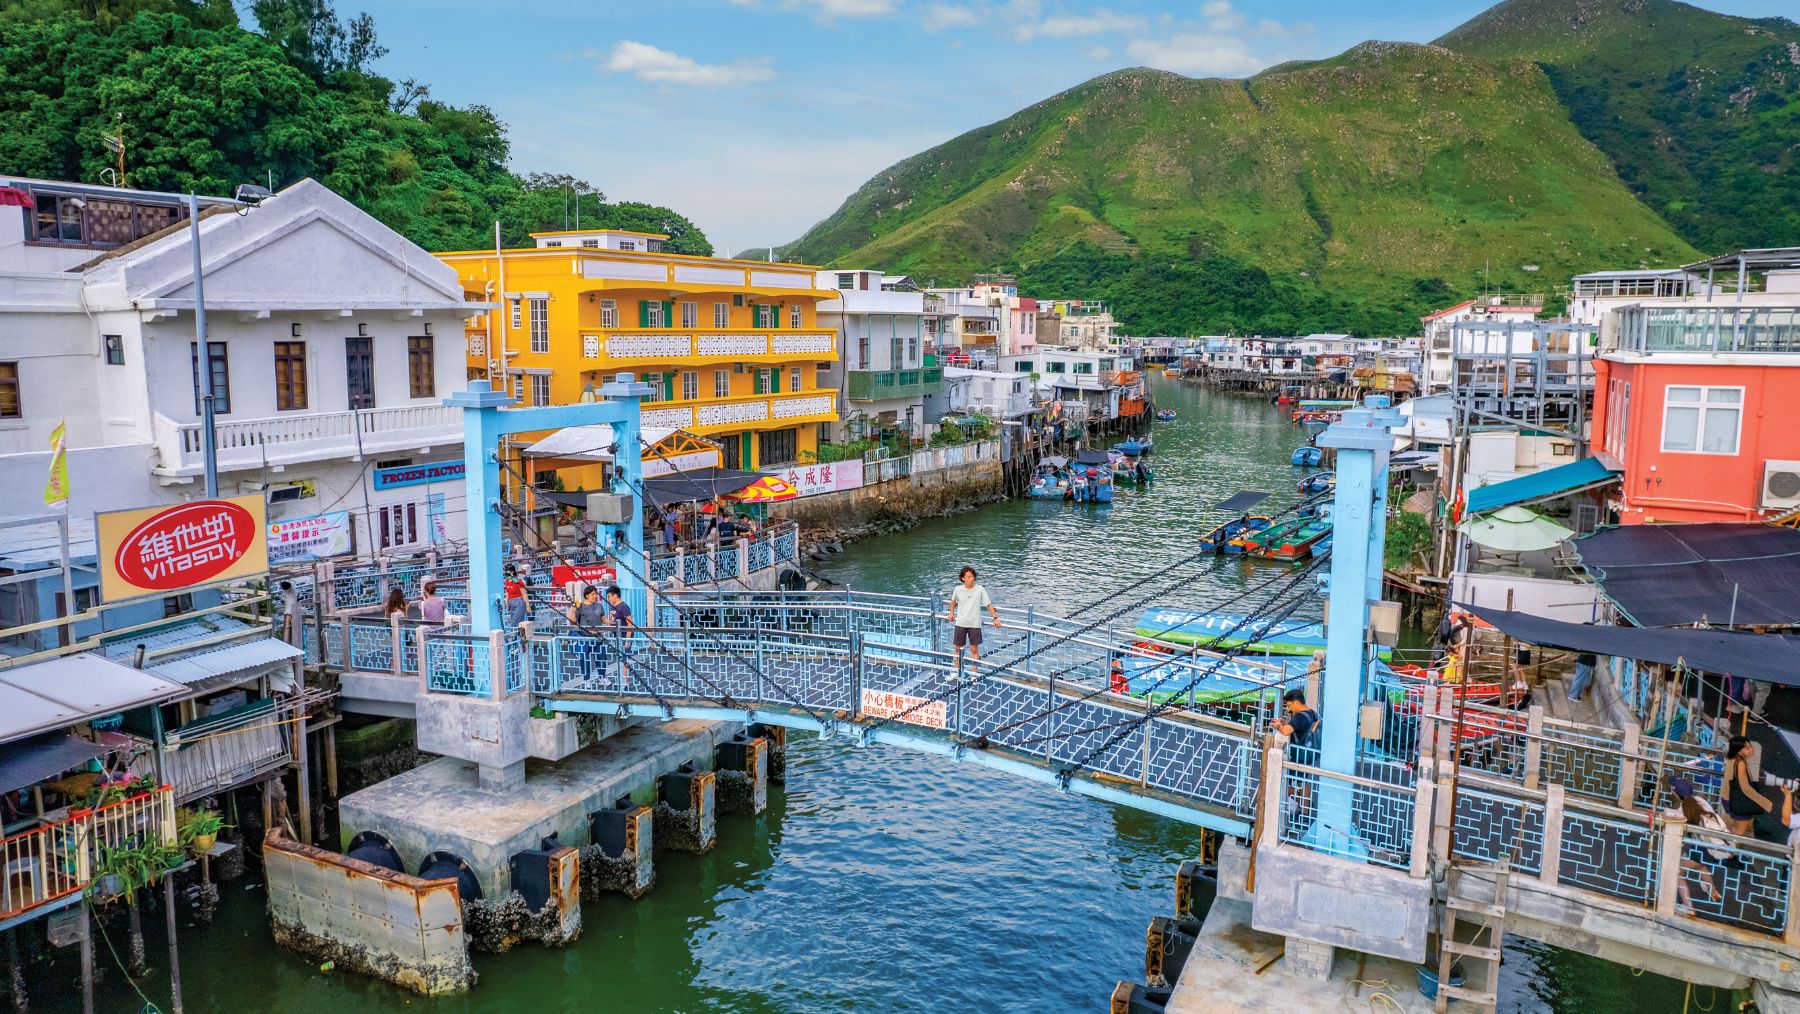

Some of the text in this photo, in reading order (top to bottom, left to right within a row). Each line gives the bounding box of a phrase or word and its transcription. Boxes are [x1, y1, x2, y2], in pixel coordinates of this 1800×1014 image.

[382, 469, 425, 484] FROZEN
[137, 511, 235, 564] 維他奶
[864, 691, 904, 711] 小心橋板
[863, 705, 888, 718] BEWARE
[901, 712, 924, 724] BRIDGE
[926, 716, 943, 728] DECK
